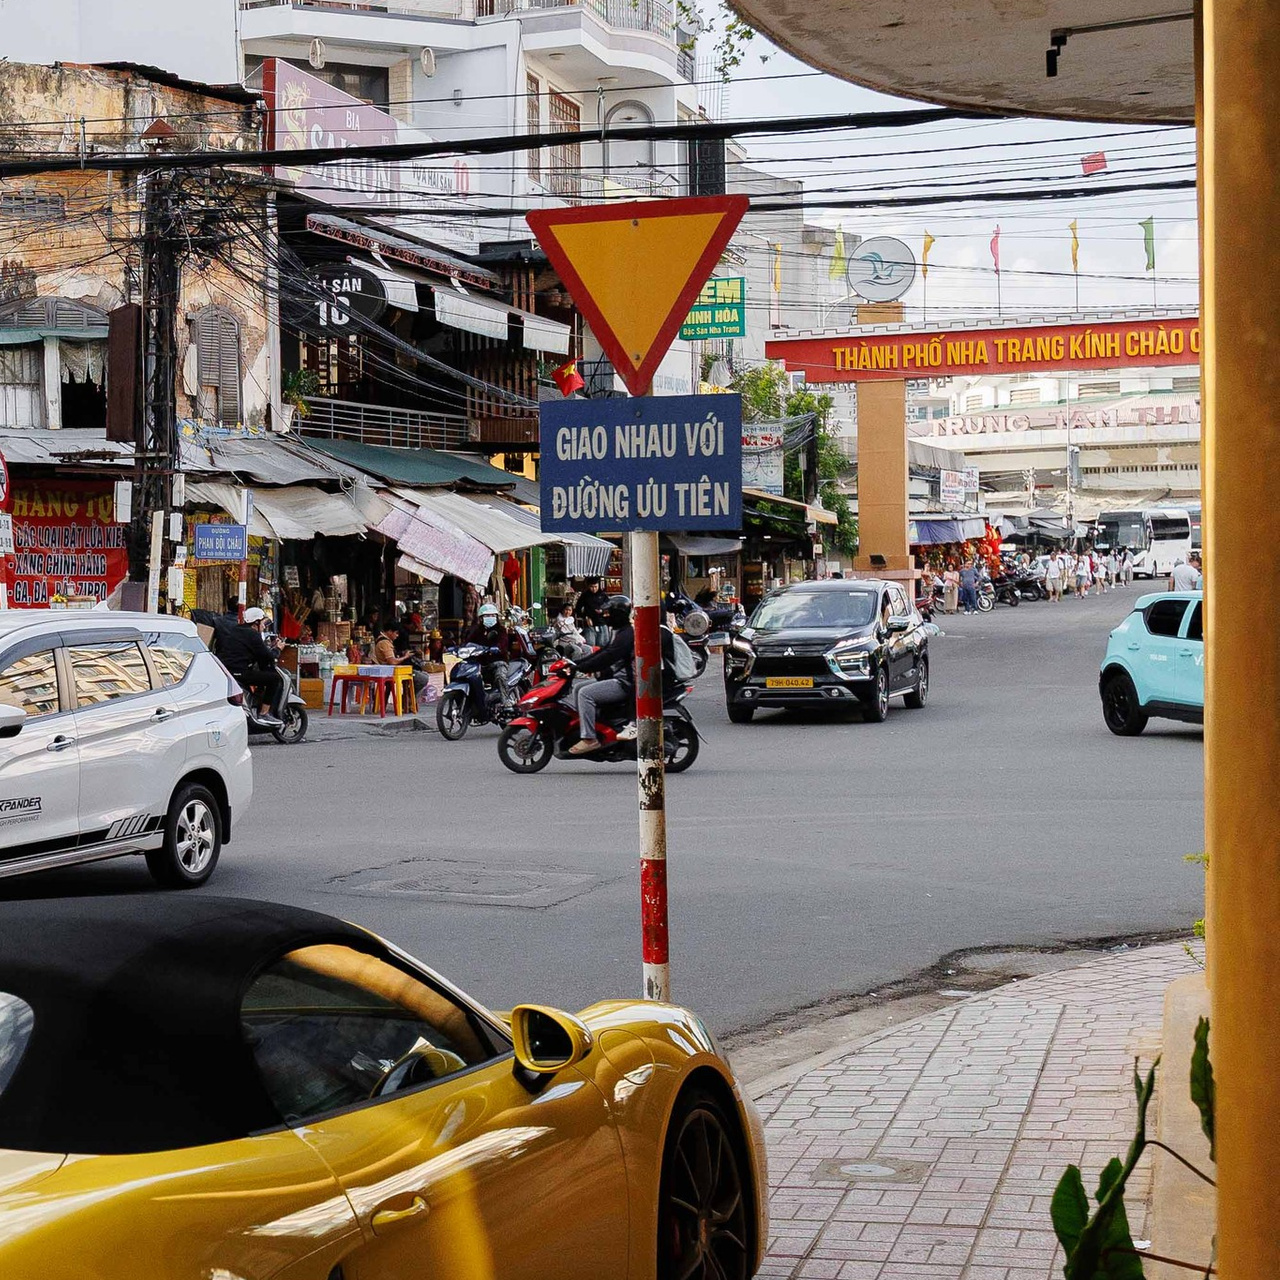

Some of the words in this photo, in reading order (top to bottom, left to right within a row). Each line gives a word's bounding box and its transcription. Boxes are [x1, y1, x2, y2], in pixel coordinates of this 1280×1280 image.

[346, 109, 360, 133] BIA
[454, 160, 469, 202] 10
[694, 278, 741, 305] EM
[314, 296, 350, 326] 10
[714, 307, 739, 323] HÒA
[683, 327, 695, 337] Đặc
[696, 326, 708, 336] Sản
[709, 325, 721, 334] Nha
[723, 325, 740, 335] Trang
[832, 341, 899, 371] THÀNH
[902, 334, 945, 369] PHỐ
[946, 338, 989, 366] NHA
[994, 335, 1065, 364] TRANG
[1069, 329, 1121, 360] KÍNH
[1125, 324, 1186, 356] CHÀO
[556, 425, 608, 461] GIAO
[615, 423, 677, 459] NHAU
[684, 412, 724, 457] VỚI
[928, 414, 1031, 437] TRUNG
[552, 475, 630, 519] ĐƯỜNG
[636, 477, 667, 518] ƯU
[674, 474, 730, 517] TIÊN
[16, 521, 37, 548] CÁC
[38, 525, 61, 554] LOẠI
[62, 523, 82, 554] BẬT
[83, 521, 105, 548] LỬA
[198, 537, 214, 549] PHAN
[215, 535, 226, 550] BỘI
[227, 535, 242, 549] CHÂU
[15, 549, 44, 576] XĂNG
[45, 548, 77, 576] CHÍNH
[14, 581, 31, 604] GA,
